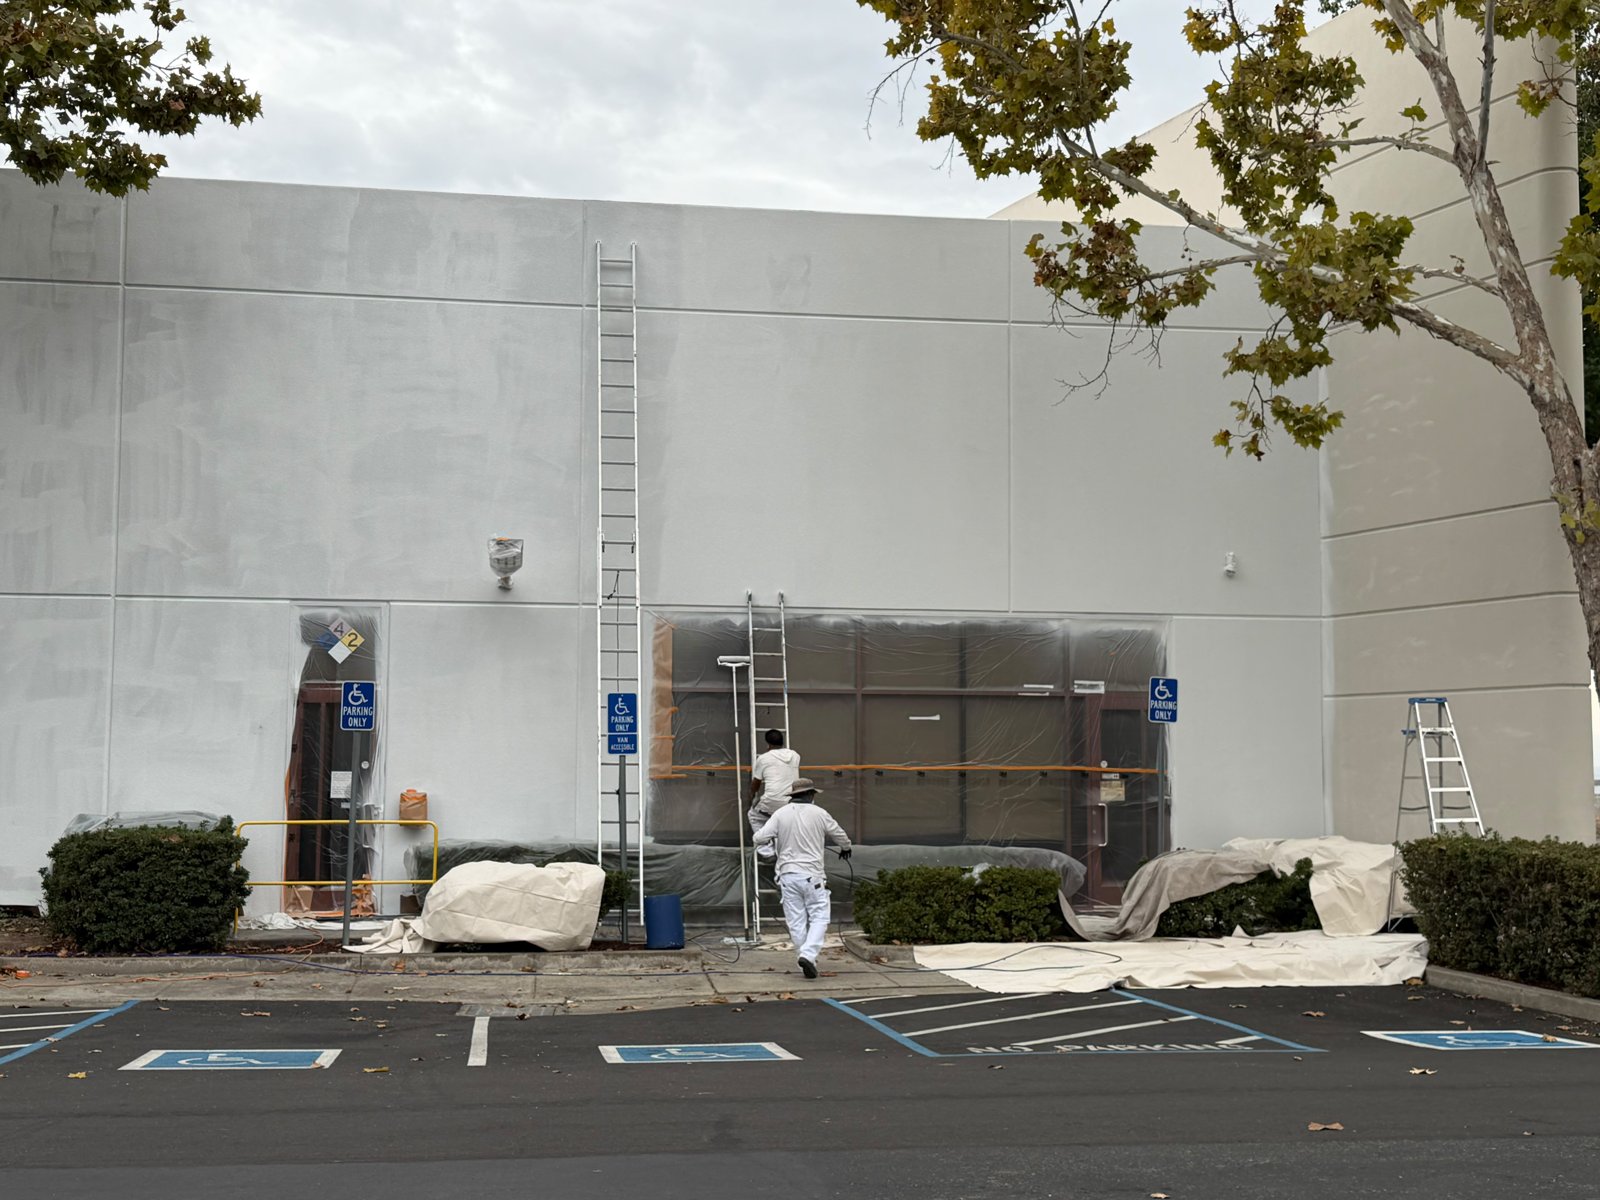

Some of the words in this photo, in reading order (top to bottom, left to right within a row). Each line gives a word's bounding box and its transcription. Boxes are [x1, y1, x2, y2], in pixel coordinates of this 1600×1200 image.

[333, 622, 344, 637] 4
[347, 632, 358, 648] 2
[1150, 700, 1177, 710] PARKING
[343, 706, 373, 716] PARKING
[1154, 710, 1172, 720] ONLY
[348, 717, 367, 727] ONLY
[610, 715, 634, 724] PARKING
[615, 724, 630, 732] ONLY
[966, 1045, 1034, 1053] NO
[1054, 1043, 1254, 1052] PARKING
